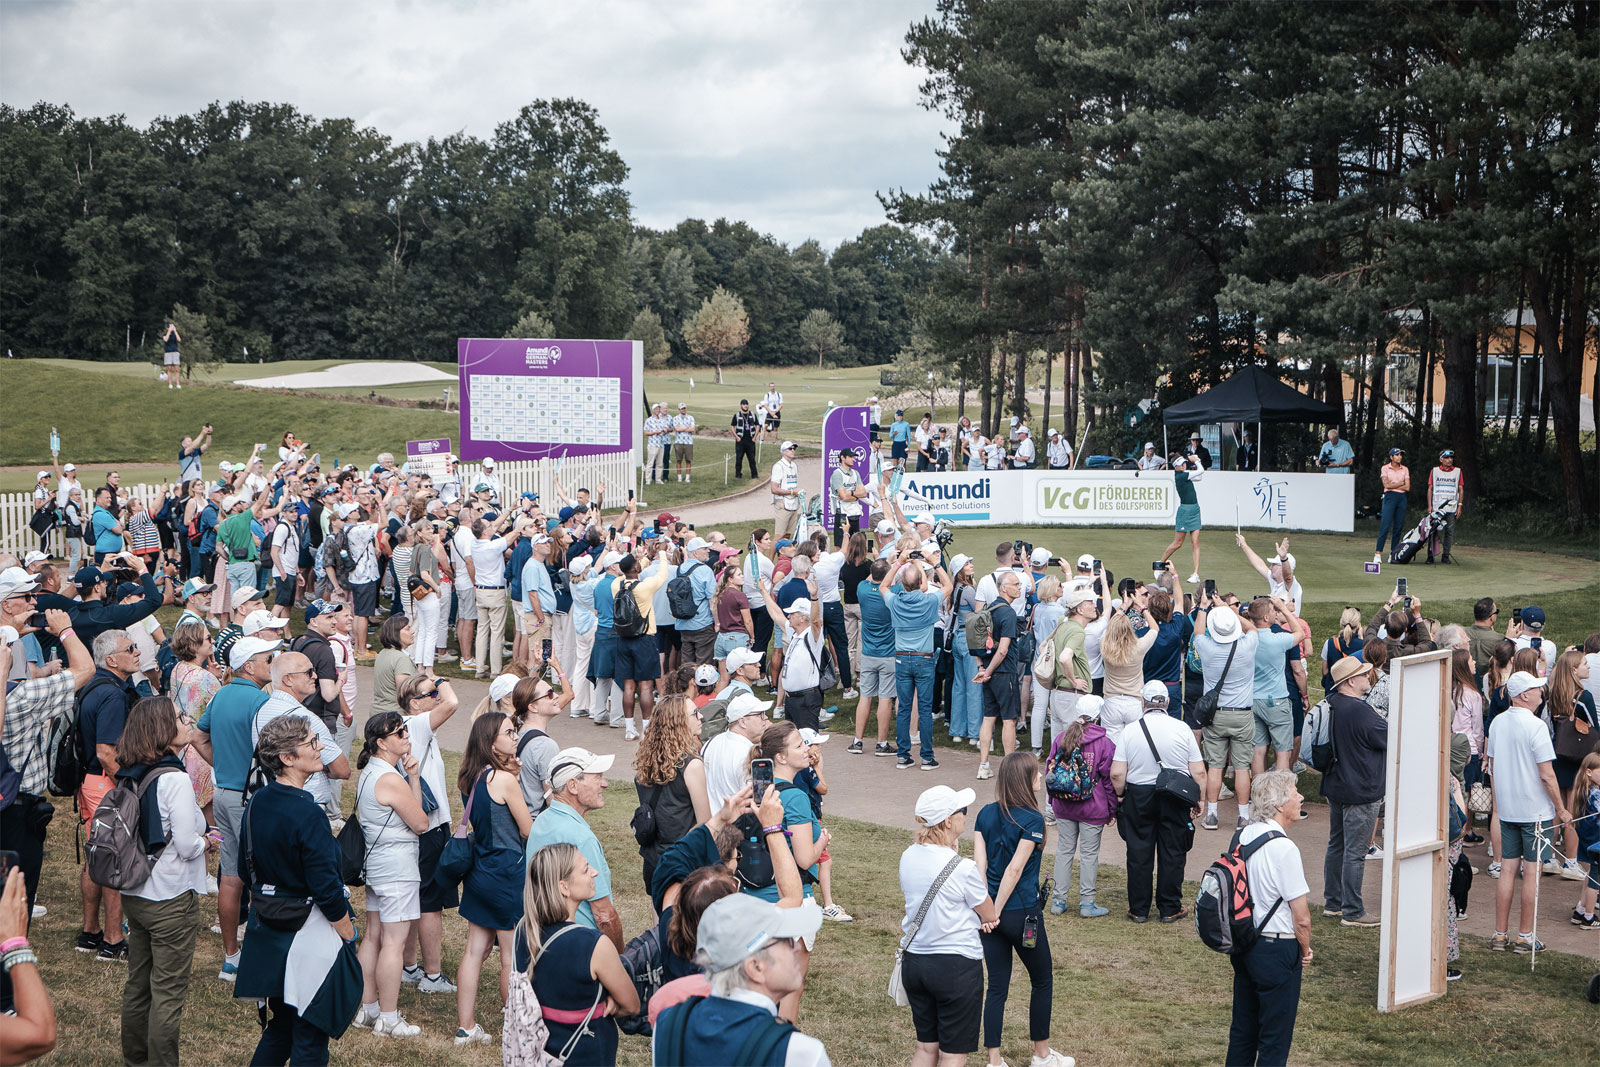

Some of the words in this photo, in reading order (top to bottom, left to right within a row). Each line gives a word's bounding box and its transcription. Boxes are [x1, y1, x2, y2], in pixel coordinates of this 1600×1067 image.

[860, 411, 867, 427] 1
[904, 478, 990, 500] Amundi
[1099, 484, 1163, 500] FÖRDERER
[1044, 487, 1091, 510] VcG
[1099, 502, 1113, 510] DES
[1116, 502, 1163, 510] GOLFSPORTS
